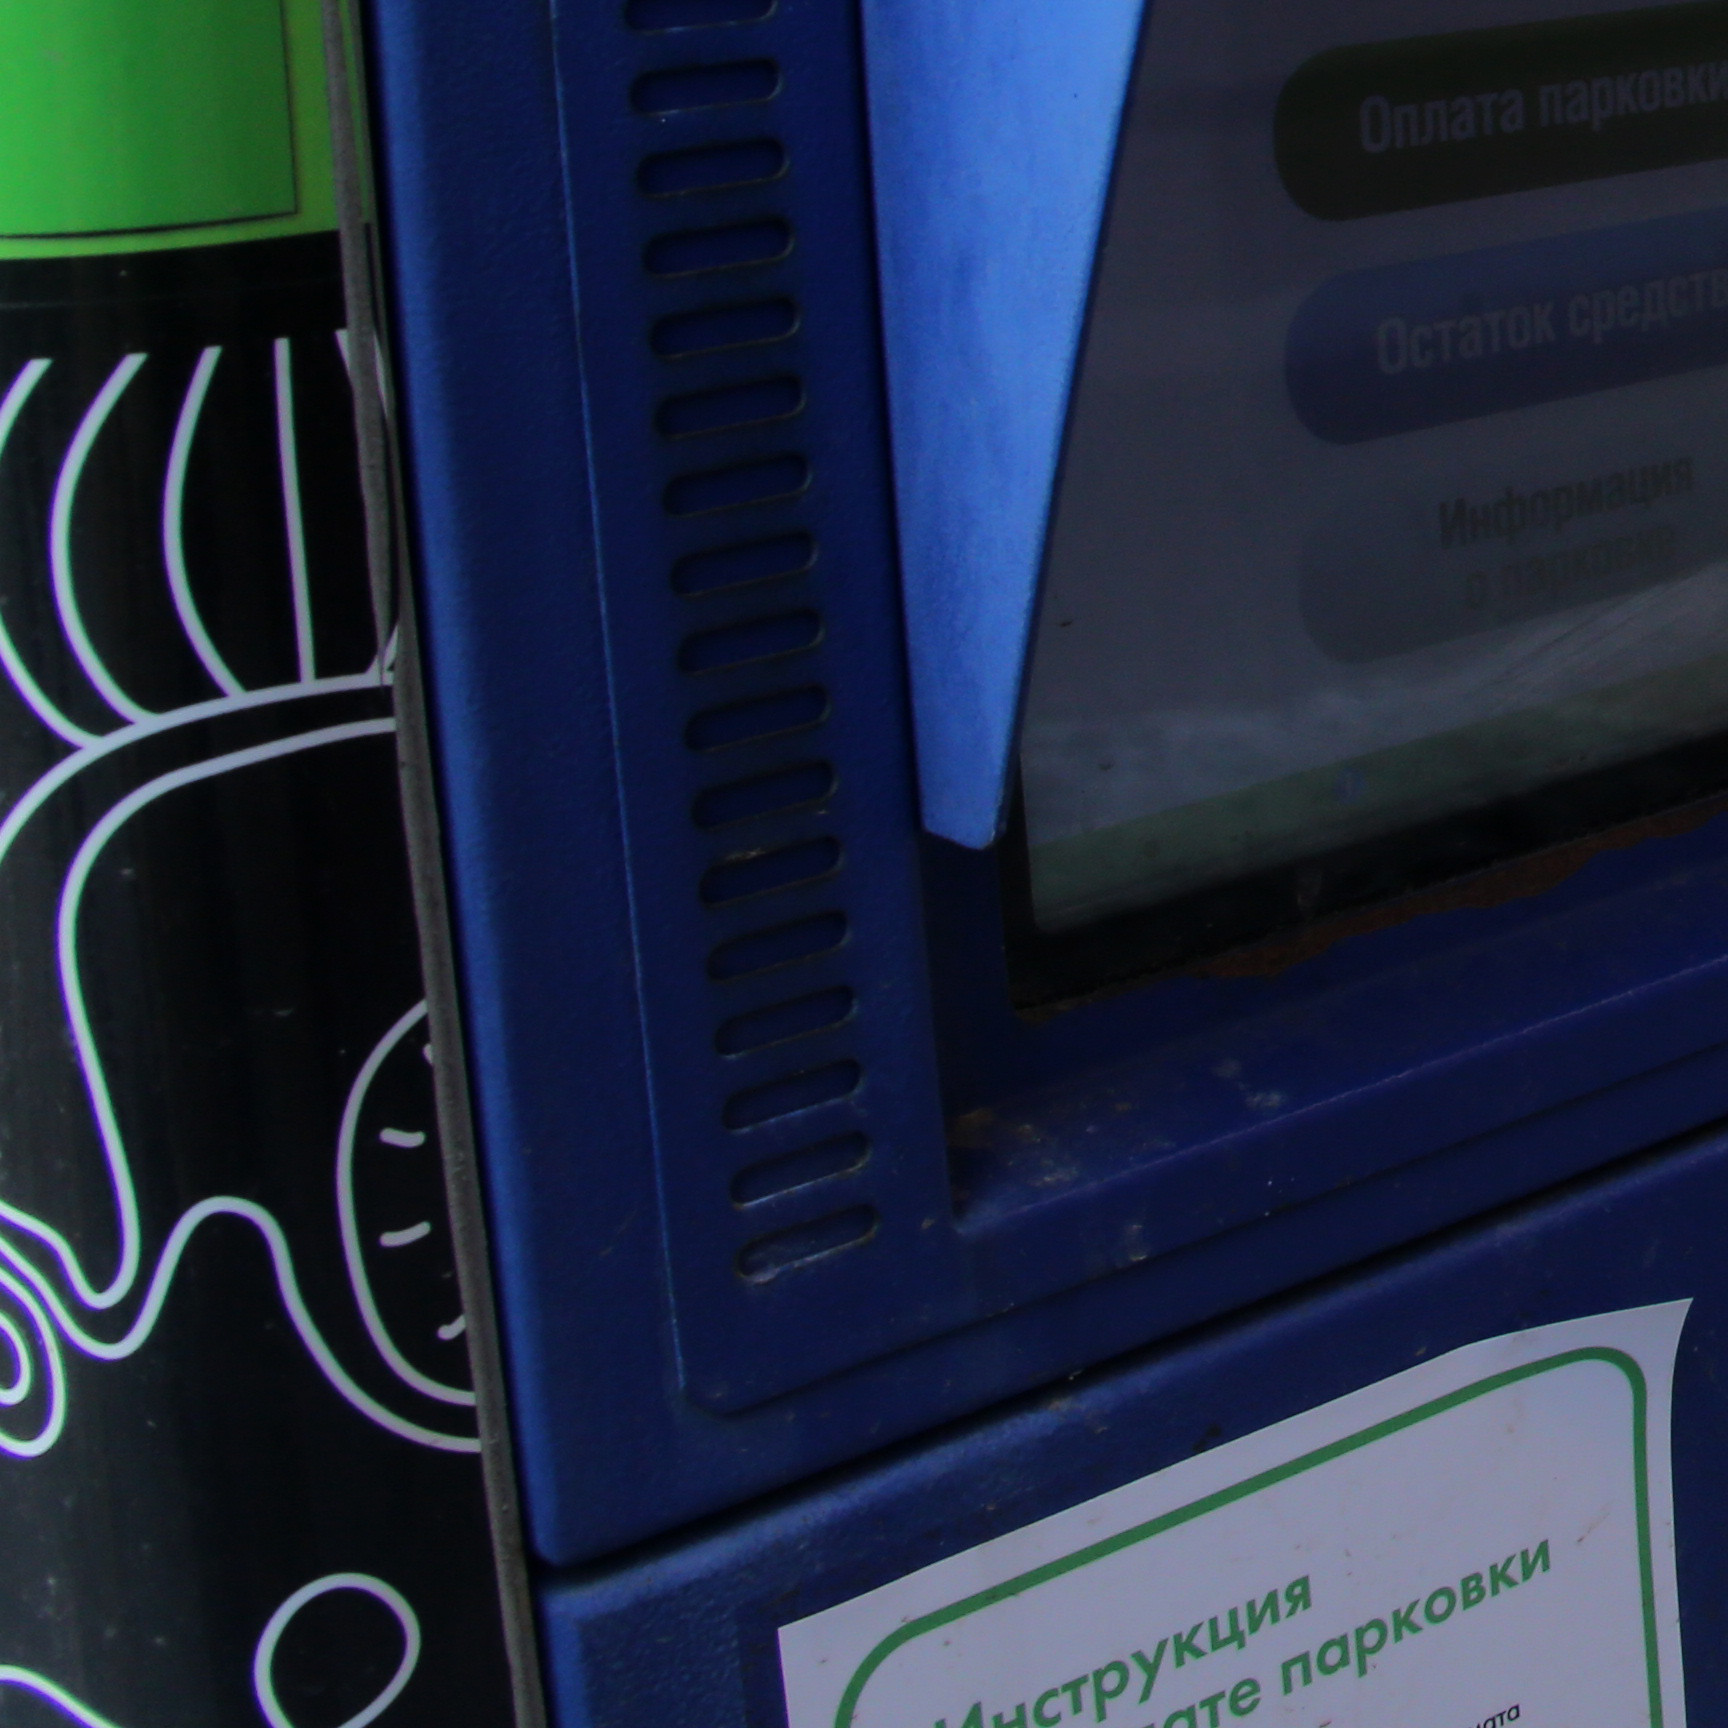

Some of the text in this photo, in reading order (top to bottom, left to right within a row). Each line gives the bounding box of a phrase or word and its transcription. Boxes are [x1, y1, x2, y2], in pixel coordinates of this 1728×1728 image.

[1358, 88, 1526, 155] Оплата
[1375, 301, 1557, 375] Остаток
[1438, 455, 1694, 549] Информация
[1464, 571, 1488, 610] о
[1141, 1539, 1551, 1728] ате парковки
